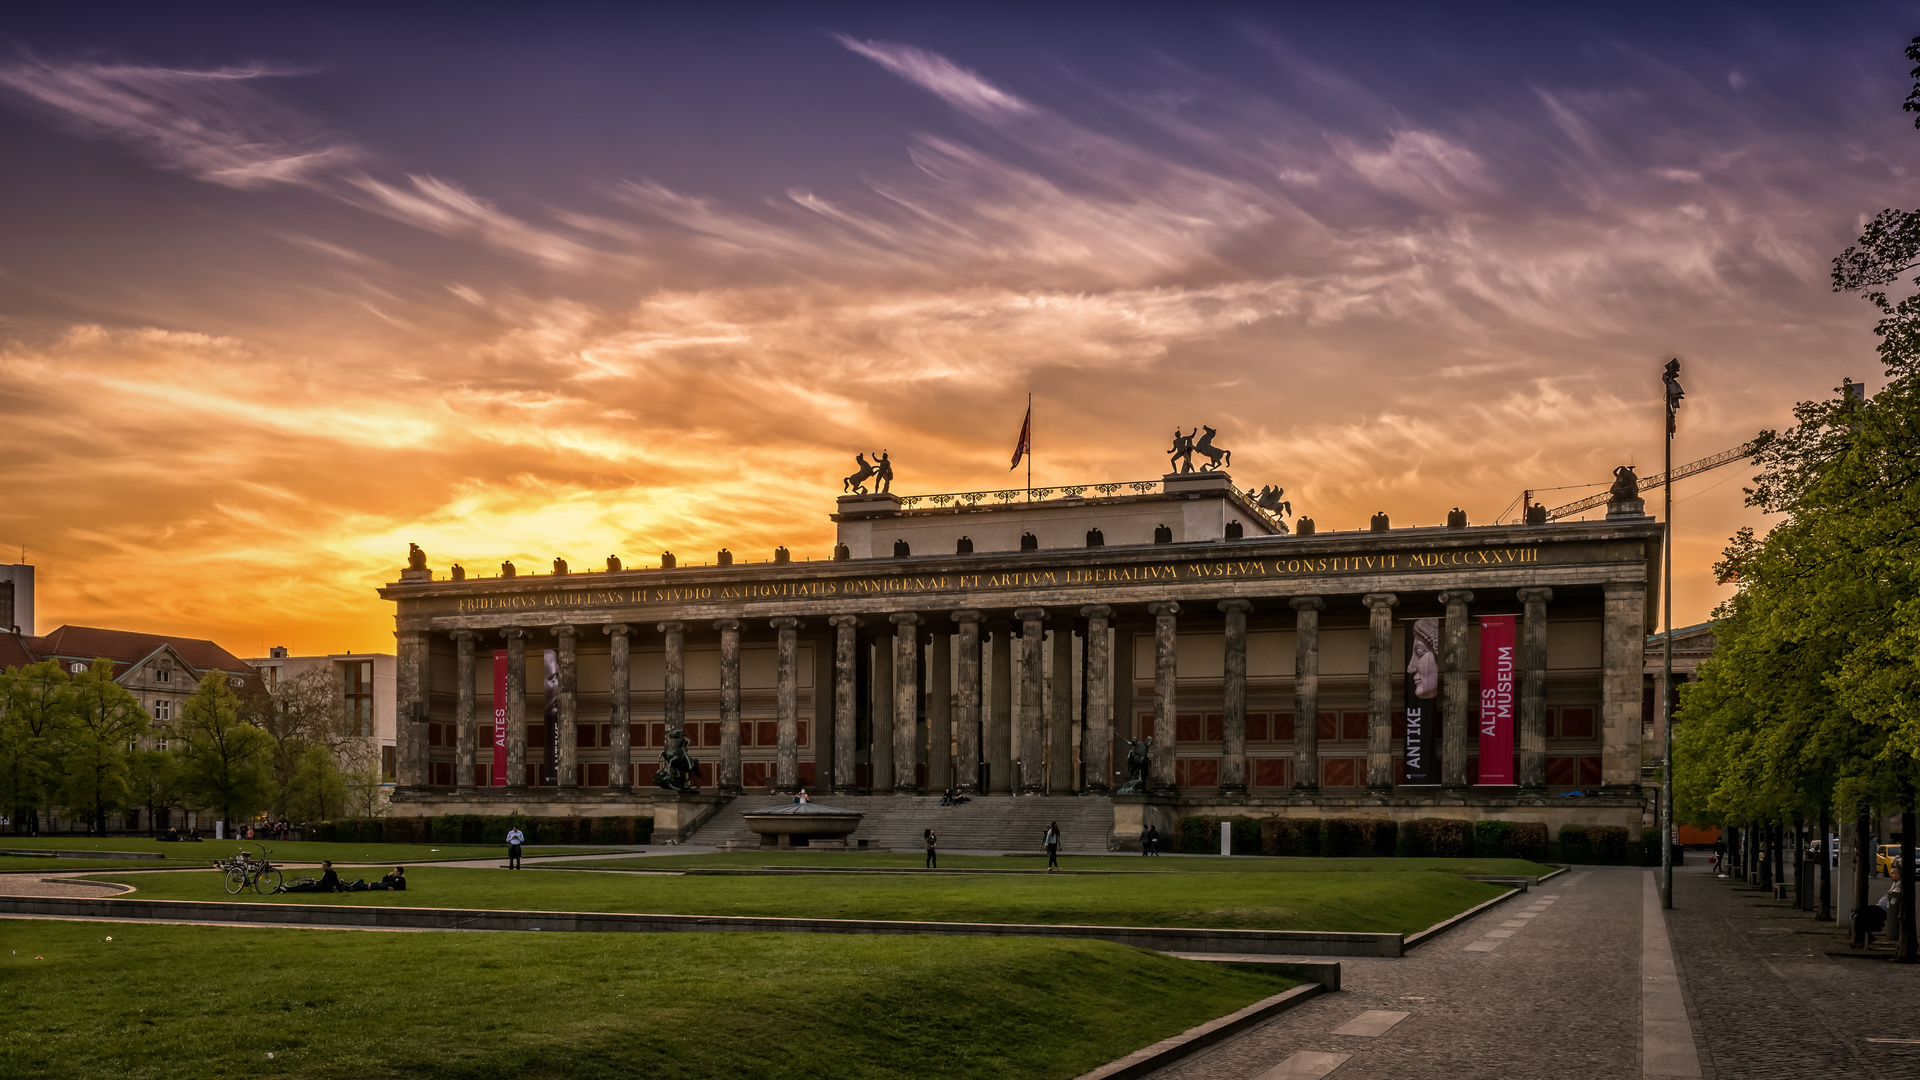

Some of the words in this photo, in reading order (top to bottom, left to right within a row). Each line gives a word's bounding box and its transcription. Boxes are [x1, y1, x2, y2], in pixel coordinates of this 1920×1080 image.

[631, 590, 647, 603] III
[655, 587, 711, 601] STVDIO
[721, 581, 836, 600] ANTIQVITATIS
[844, 575, 952, 594] OMNIGENAE
[960, 574, 982, 589] ET
[988, 570, 1057, 587] ARTIVM
[1066, 564, 1177, 583] LIBERALIVM
[1186, 561, 1266, 578] MVSEVM
[1275, 555, 1400, 574] CONSTITVIT
[1409, 548, 1539, 568] MDCCCXXVIII
[1497, 646, 1513, 718] MUSEUM
[495, 708, 505, 747] ALTES
[1406, 707, 1421, 769] ANTIKE
[1481, 688, 1496, 737] ALTES
